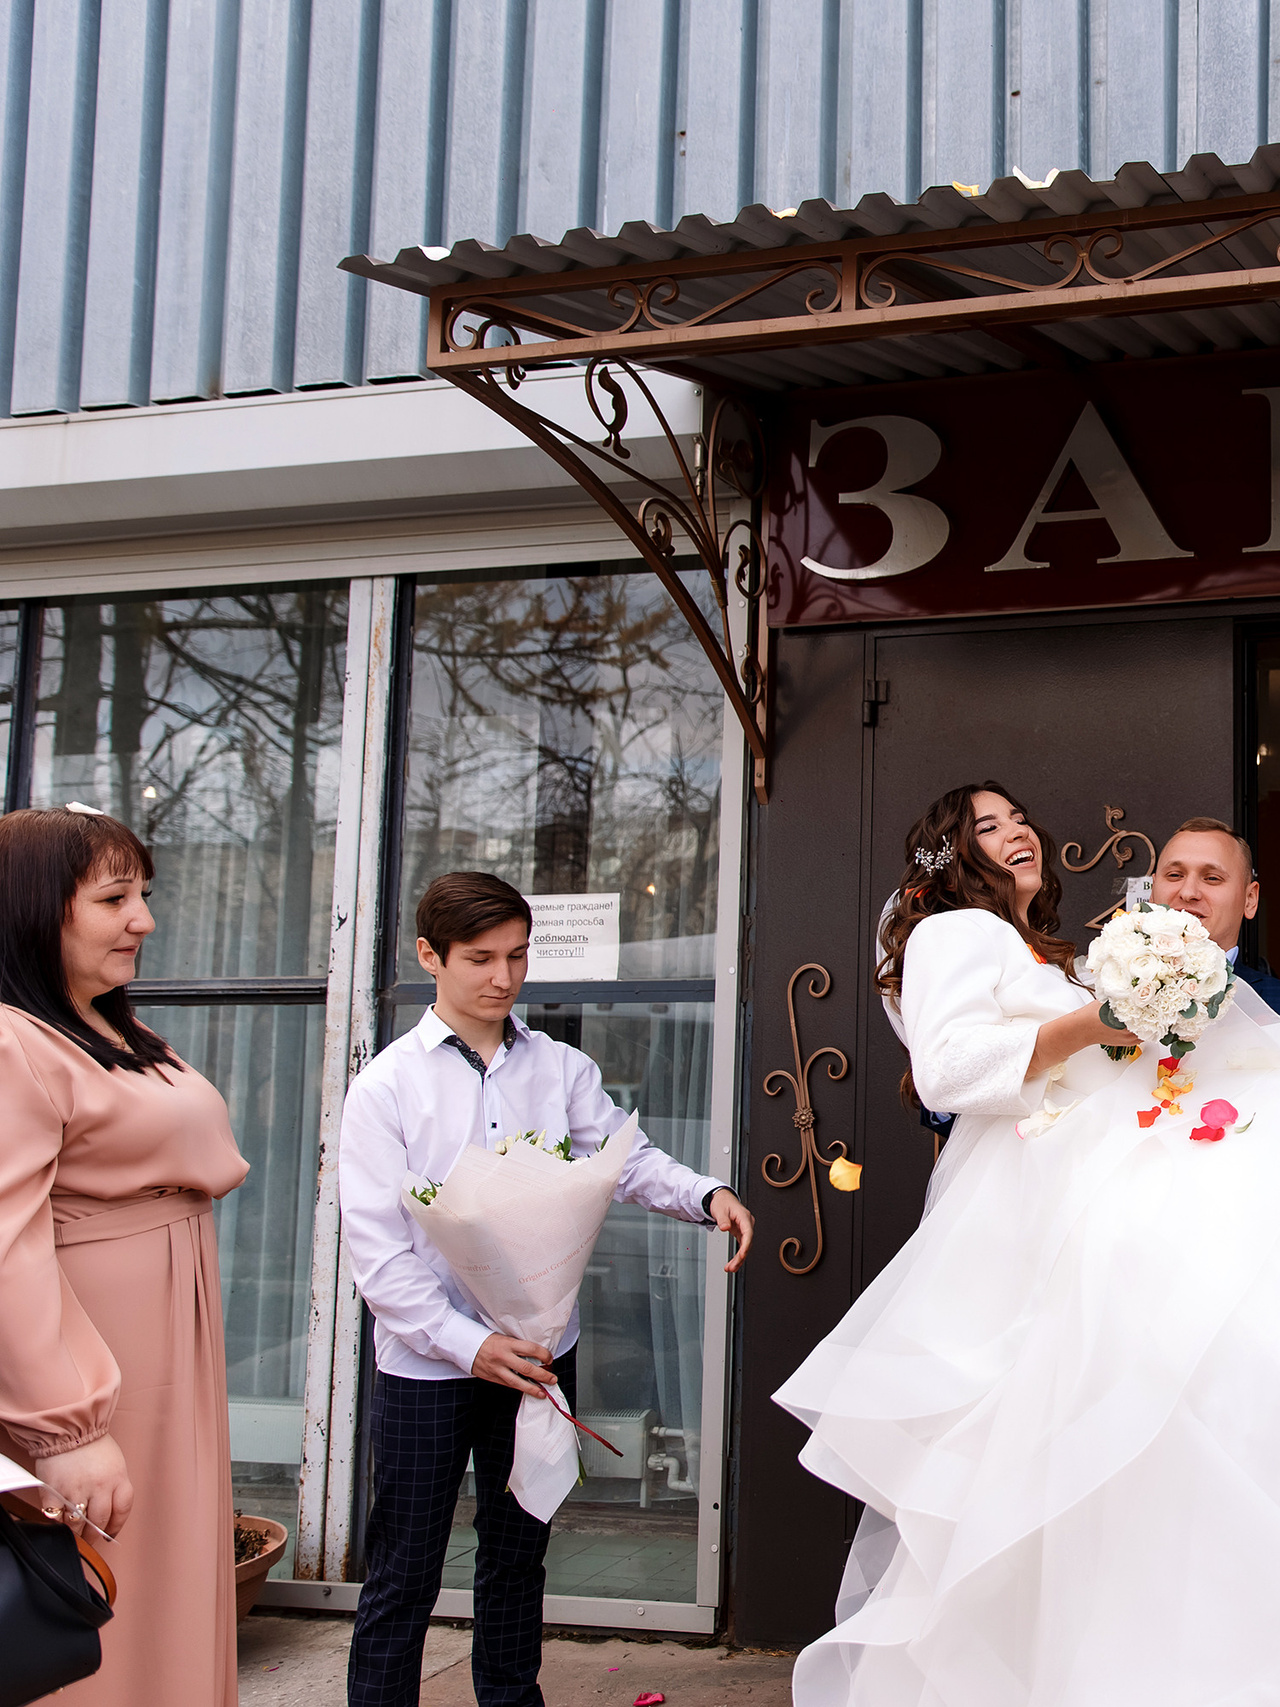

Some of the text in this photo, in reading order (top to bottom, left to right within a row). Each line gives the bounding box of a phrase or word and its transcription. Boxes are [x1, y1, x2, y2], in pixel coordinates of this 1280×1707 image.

[567, 901, 613, 912] граждане!
[566, 917, 604, 928] просьба
[533, 933, 589, 944] соблюдать
[536, 947, 585, 958] чистоту!!!
[518, 1267, 550, 1284] Original
